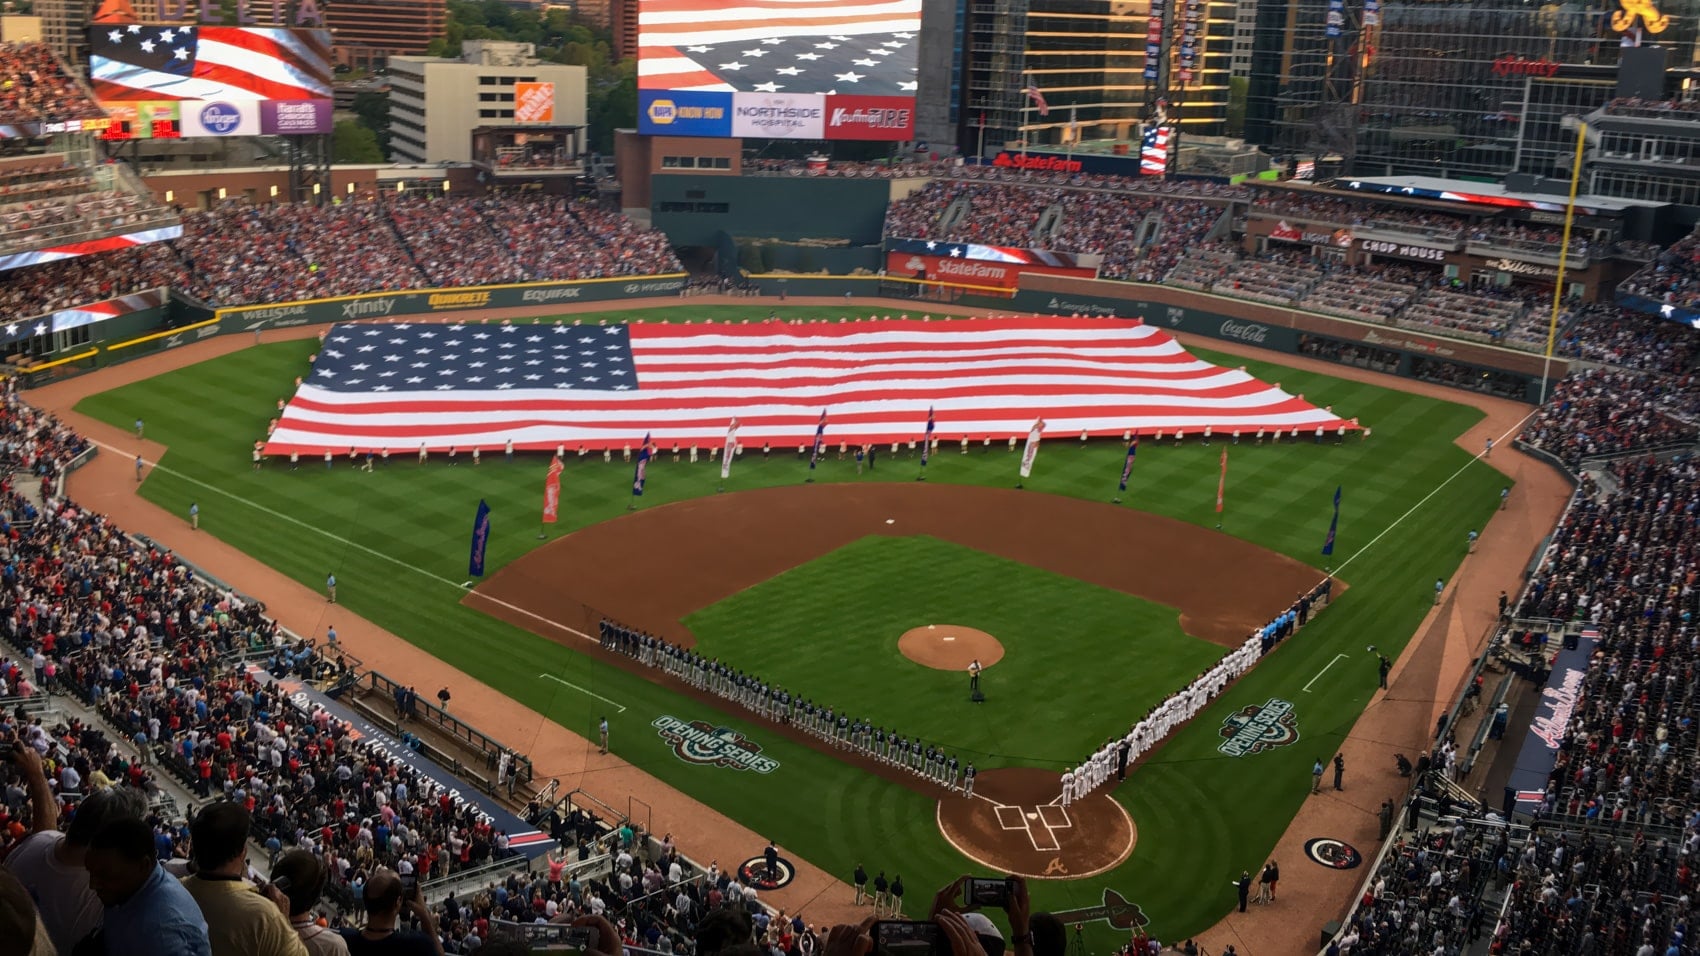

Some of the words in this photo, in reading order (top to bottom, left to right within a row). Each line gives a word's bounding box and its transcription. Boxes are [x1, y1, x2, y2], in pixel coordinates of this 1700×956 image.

[515, 82, 553, 121] HOME
[203, 107, 239, 130] Kroger
[653, 106, 673, 117] NAPA
[737, 106, 820, 118] NORTHSIDE
[868, 108, 910, 128] TIRE
[1301, 231, 1331, 244] LIGHT
[1361, 240, 1397, 254] CHOP
[1400, 246, 1446, 261] HOUSE
[937, 260, 1006, 279] StateFarm
[428, 291, 491, 305] QUIKRETE
[522, 287, 582, 302] EQUIFAX
[242, 306, 307, 321] WELLSTAR
[342, 297, 397, 318] xfinity
[1061, 301, 1089, 313] Georgia
[1090, 304, 1116, 314] Power
[1220, 319, 1269, 343] Coca-Cola
[1221, 721, 1269, 756] OPENING
[1254, 699, 1291, 725] SERIES
[654, 717, 724, 749] OPENING
[719, 743, 777, 772] SERIES
